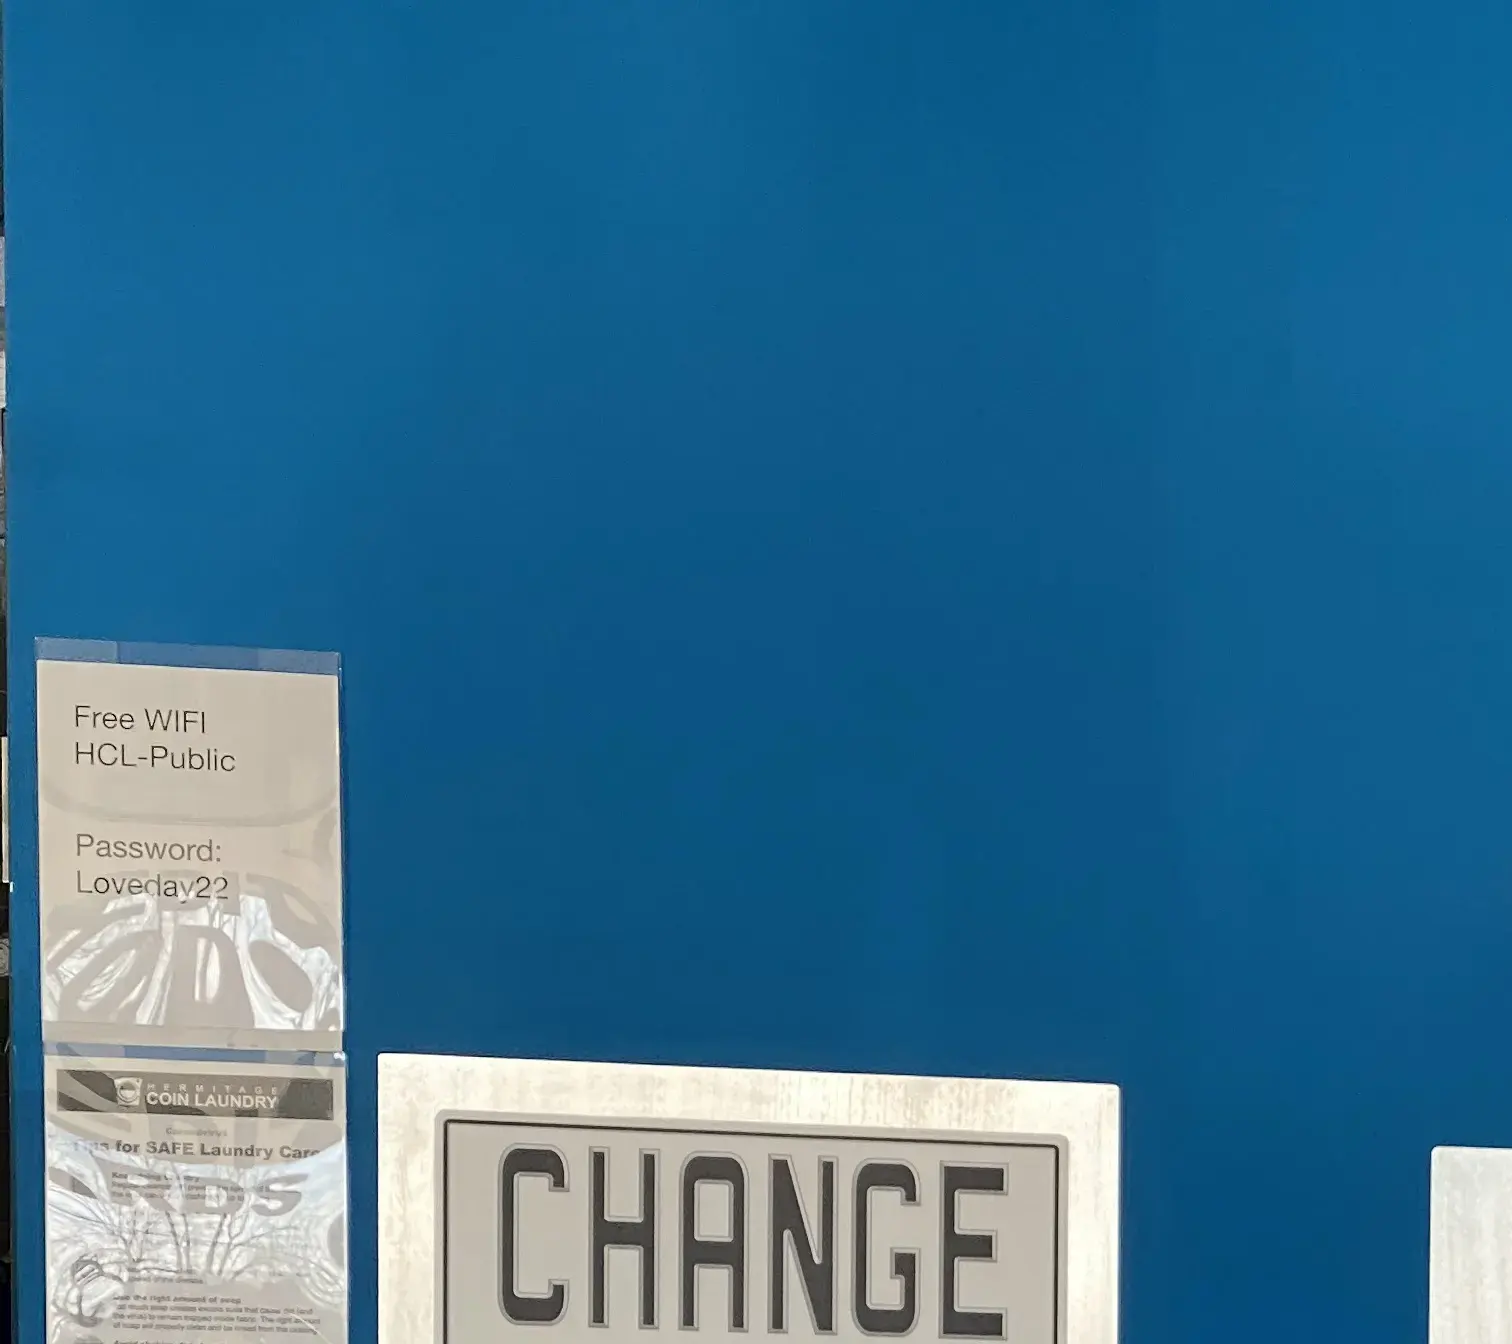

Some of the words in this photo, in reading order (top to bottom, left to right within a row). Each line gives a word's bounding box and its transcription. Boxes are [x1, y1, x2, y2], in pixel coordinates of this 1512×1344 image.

[74, 705, 135, 731] Free
[143, 707, 206, 734] WIFI
[74, 742, 236, 772] HCL-Public
[76, 834, 222, 863] Password:
[76, 870, 229, 904] Loveday22
[146, 1091, 189, 1106] COIN
[195, 1094, 277, 1109] LAUNDRY
[115, 1139, 141, 1154] for
[146, 1140, 195, 1156] SAFE
[200, 1142, 273, 1161] Laundry
[498, 1141, 1010, 1341] CHANGE
